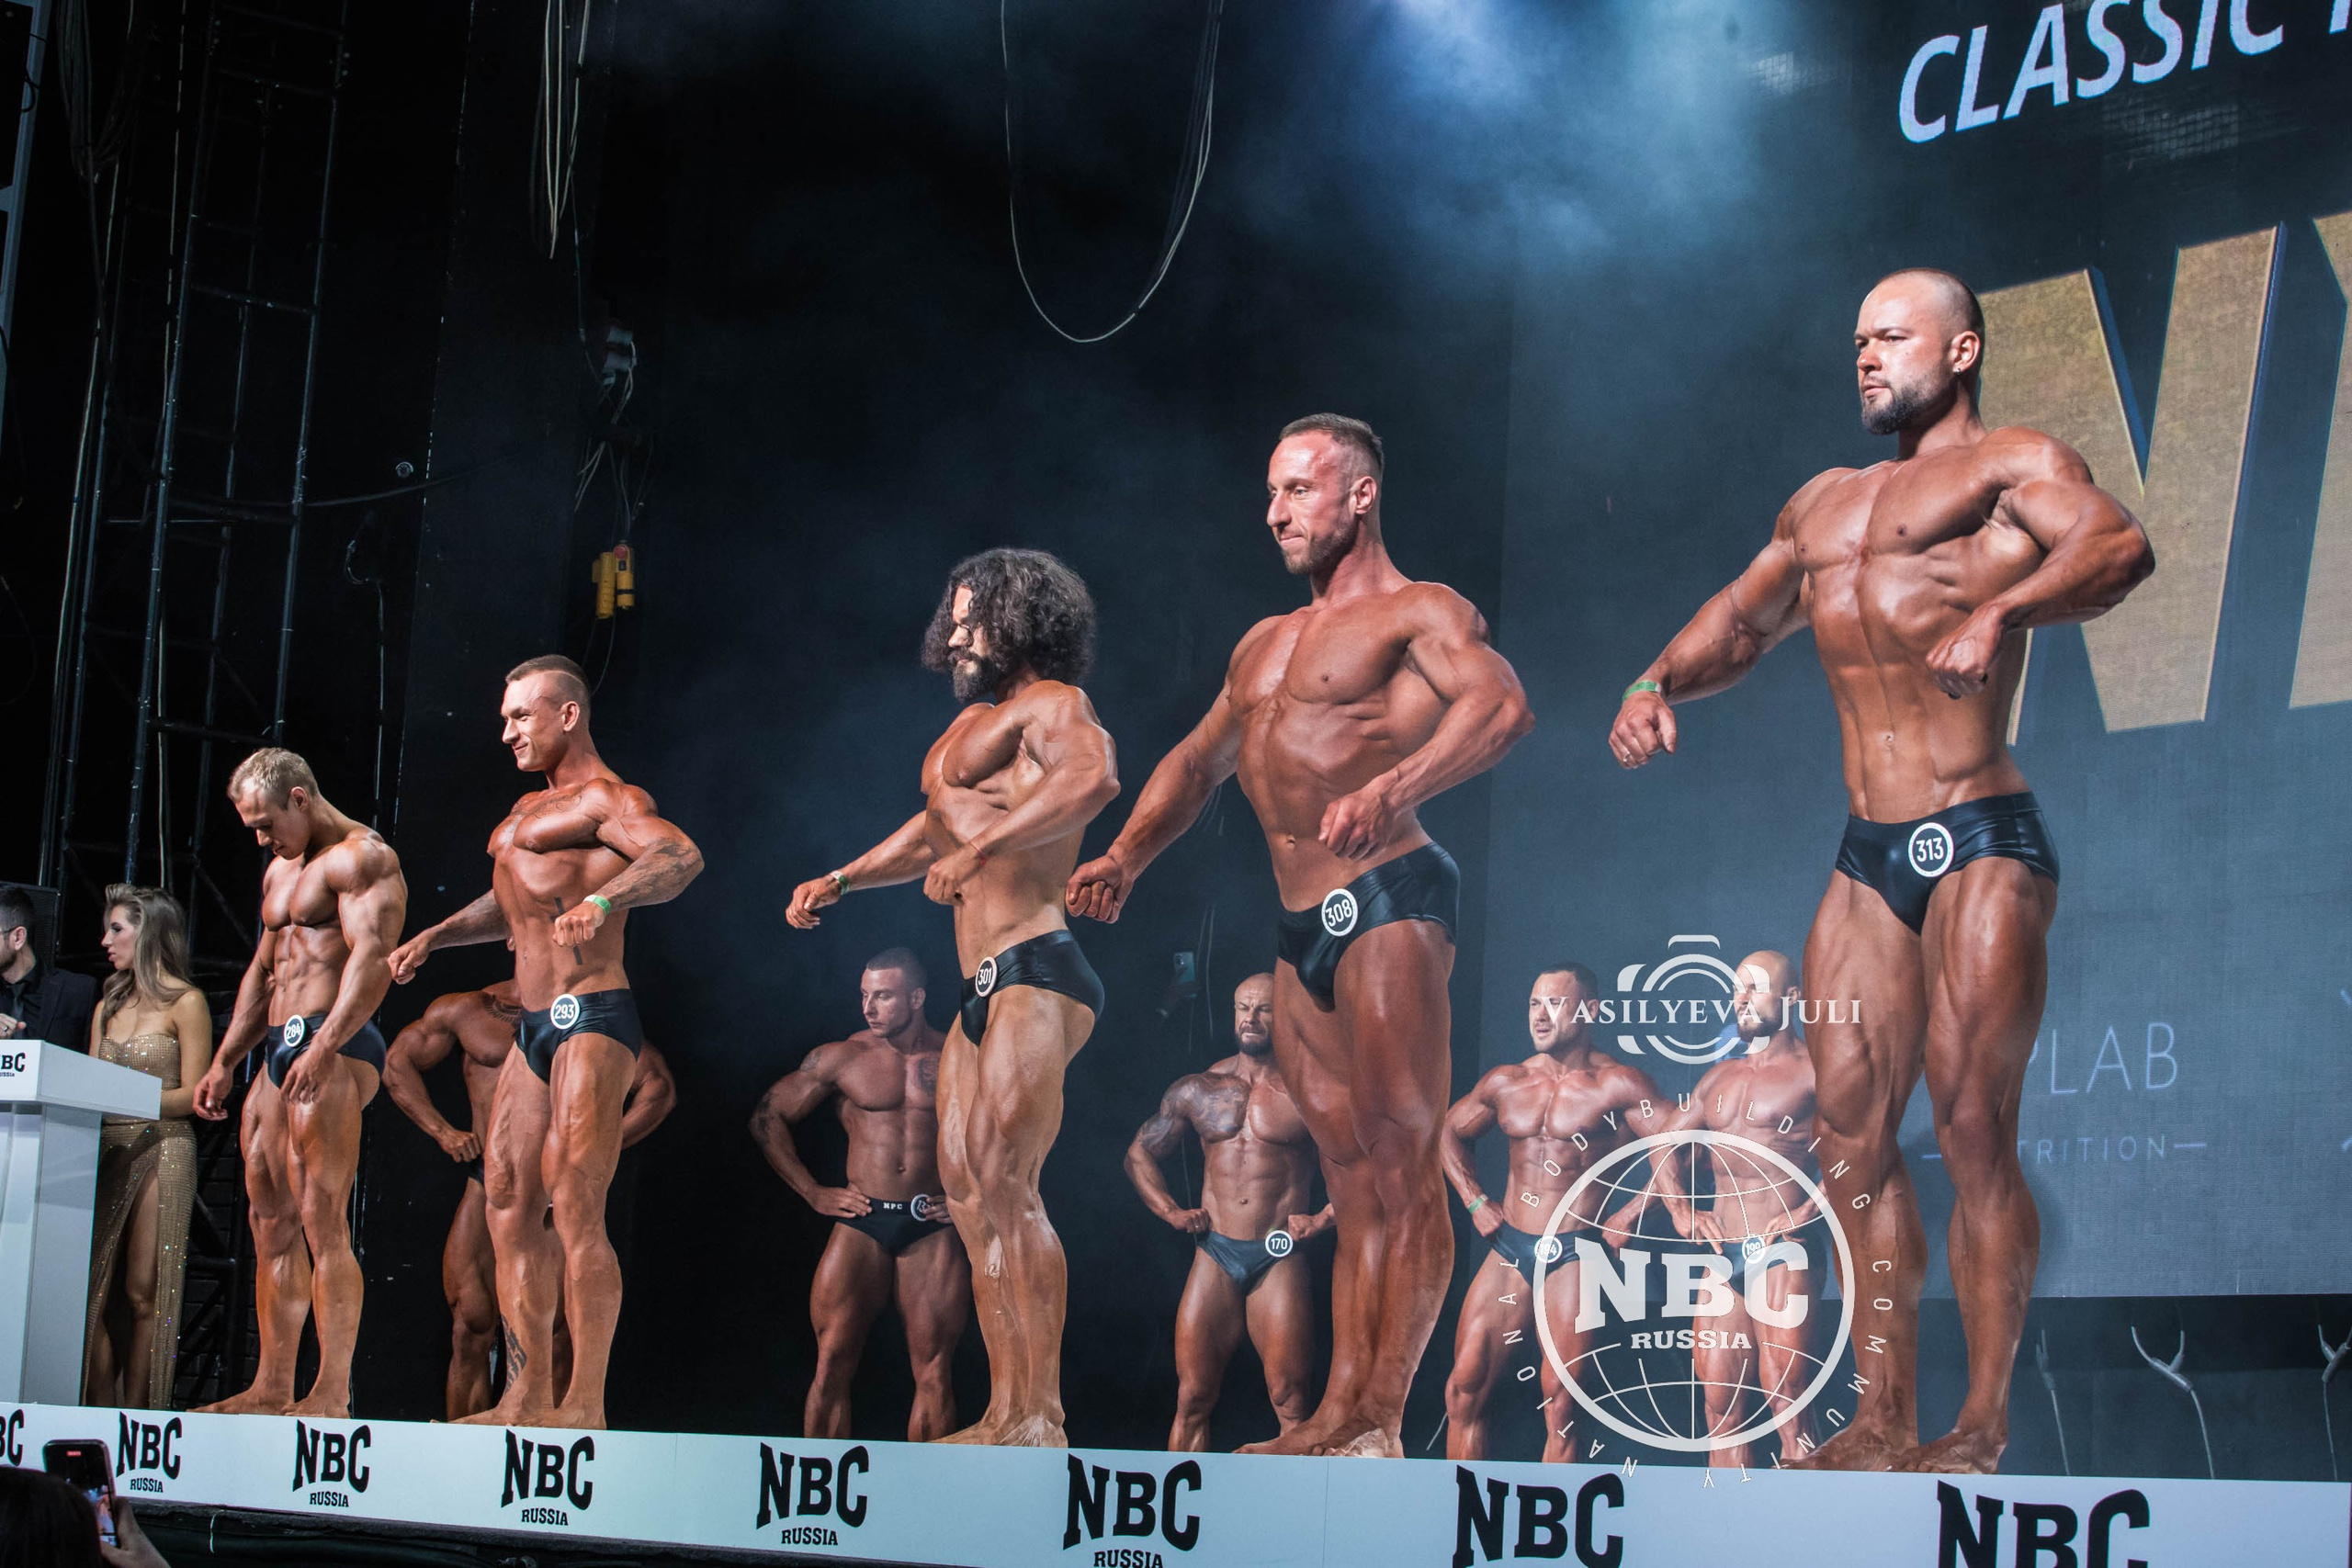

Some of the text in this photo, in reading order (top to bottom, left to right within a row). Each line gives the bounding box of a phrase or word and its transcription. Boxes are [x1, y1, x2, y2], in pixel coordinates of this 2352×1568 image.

[1916, 837, 1944, 863] 313
[1325, 898, 1352, 927] 308
[978, 967, 992, 986] 301
[554, 1004, 574, 1020] 293
[287, 1023, 301, 1040] 284
[0, 1053, 26, 1072] BC
[2029, 1021, 2178, 1094] LAB
[1270, 1237, 1286, 1250] 170
[116, 1411, 183, 1480] NBC
[292, 1419, 371, 1494] NBC
[501, 1428, 594, 1511] NBC
[130, 1477, 164, 1493] RUSSIA
[756, 1441, 870, 1529] NBC
[309, 1491, 350, 1508] RUSSIA
[1063, 1453, 1203, 1552] NBC
[521, 1507, 569, 1526] RUSSIA
[1452, 1464, 1625, 1568] NBC
[1937, 1480, 2151, 1568] NBC
[781, 1527, 839, 1546] RUSSIA
[1093, 1548, 1164, 1568] RUSSIA
